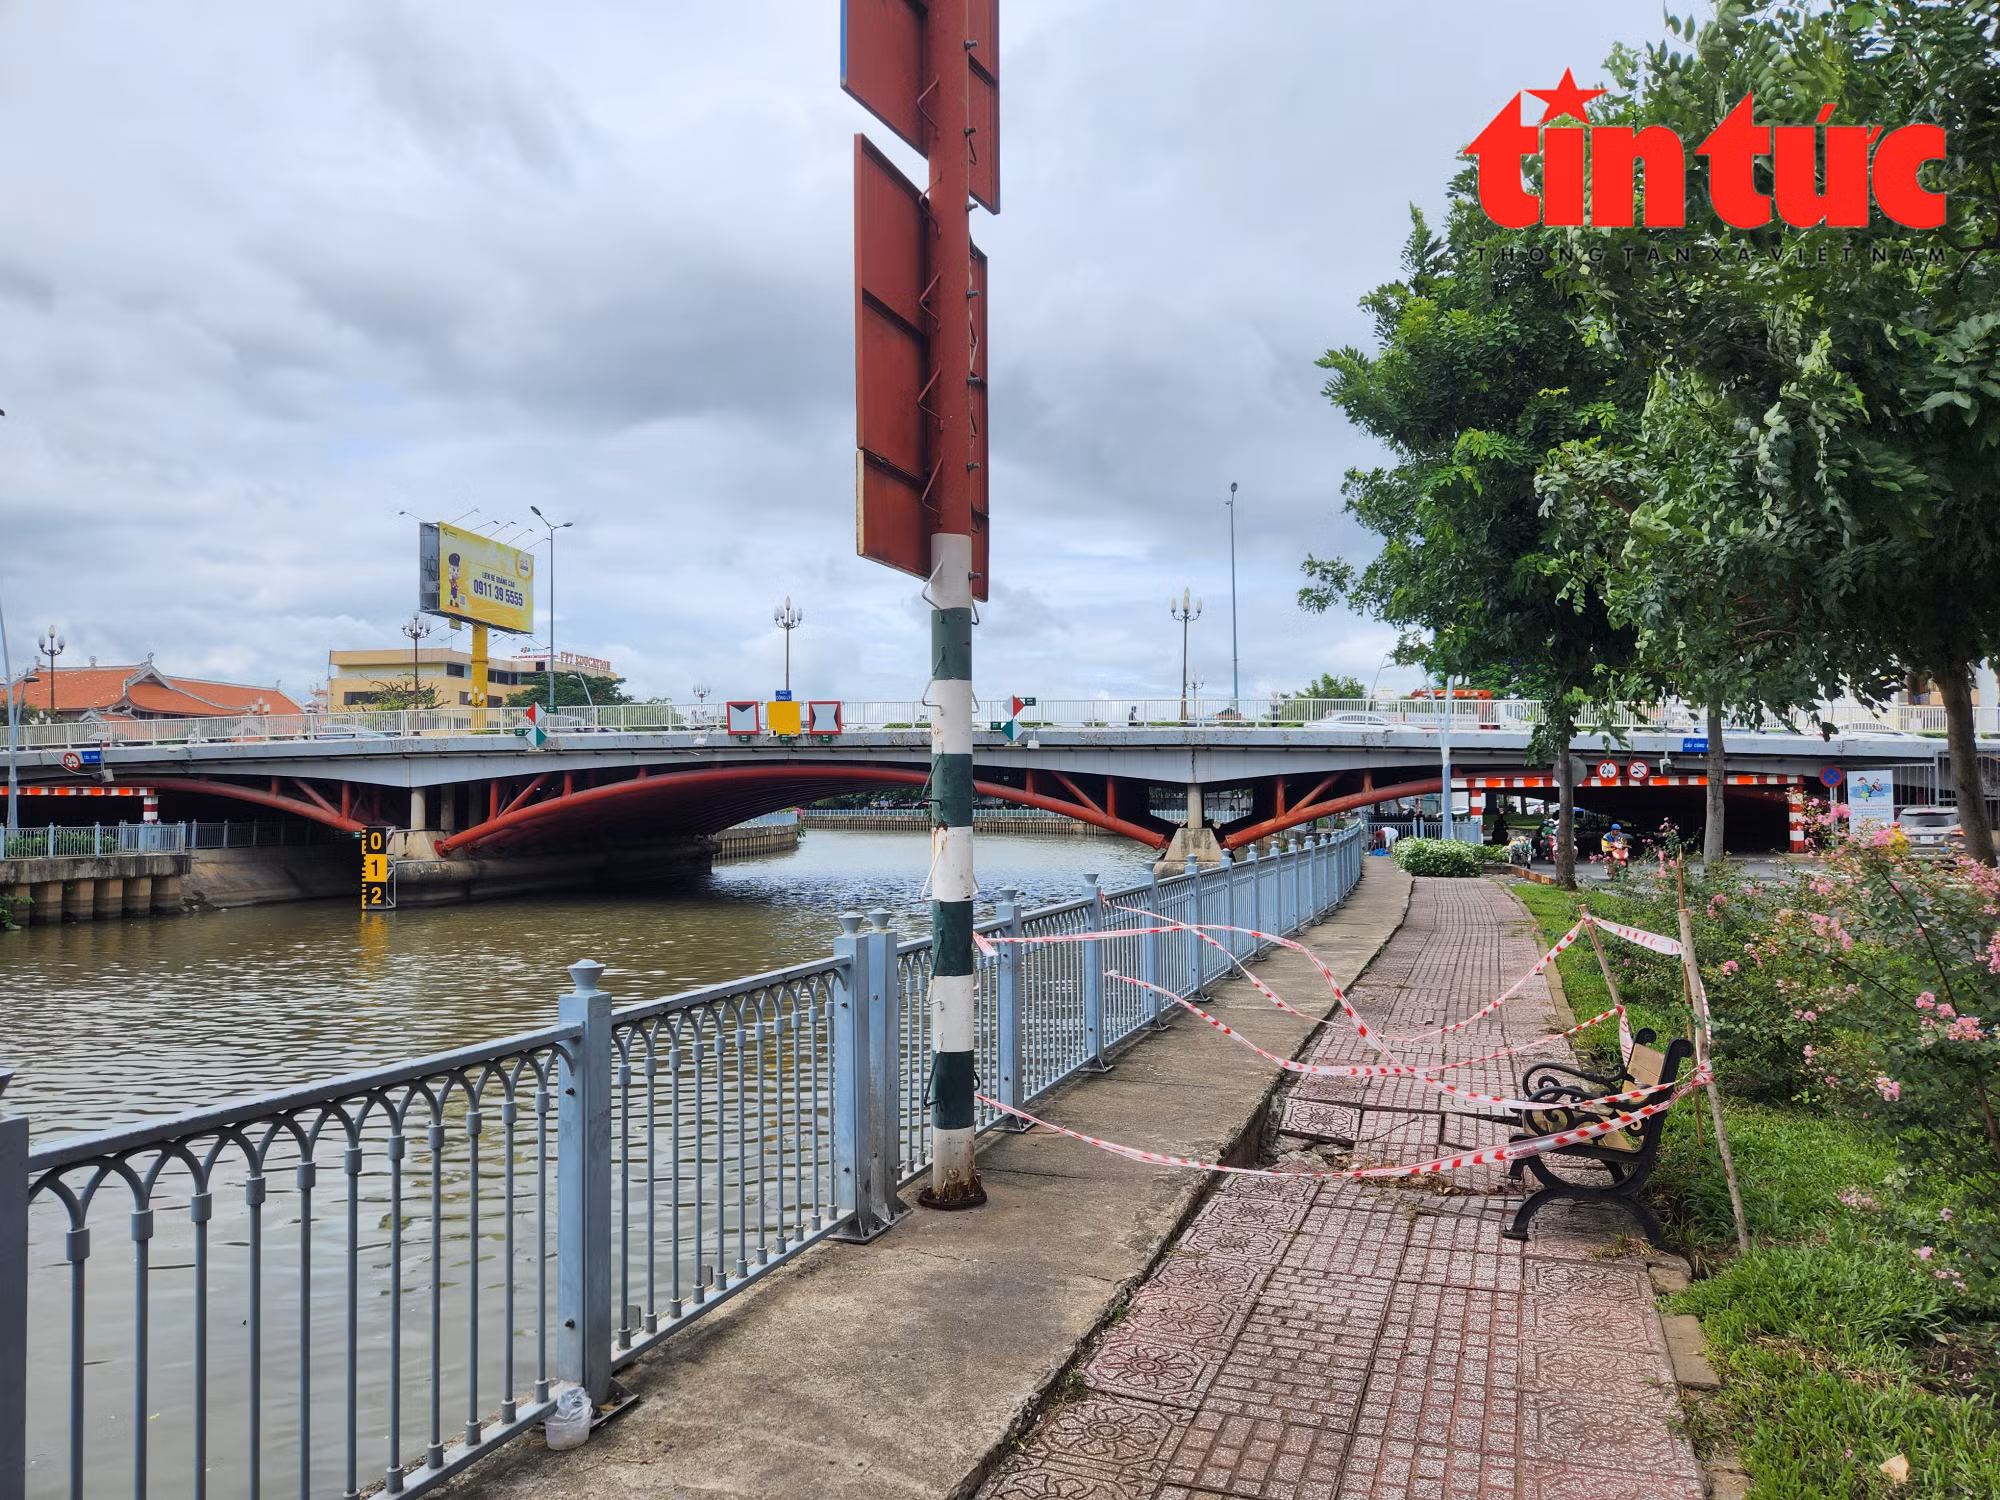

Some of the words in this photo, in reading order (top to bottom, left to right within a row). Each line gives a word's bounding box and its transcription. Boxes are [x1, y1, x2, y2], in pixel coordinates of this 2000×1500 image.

[473, 579, 492, 598] 0911
[494, 585, 504, 601] 39
[505, 589, 523, 607] 5555
[370, 832, 382, 850] 0
[371, 859, 378, 876] 1
[371, 886, 382, 904] 2
